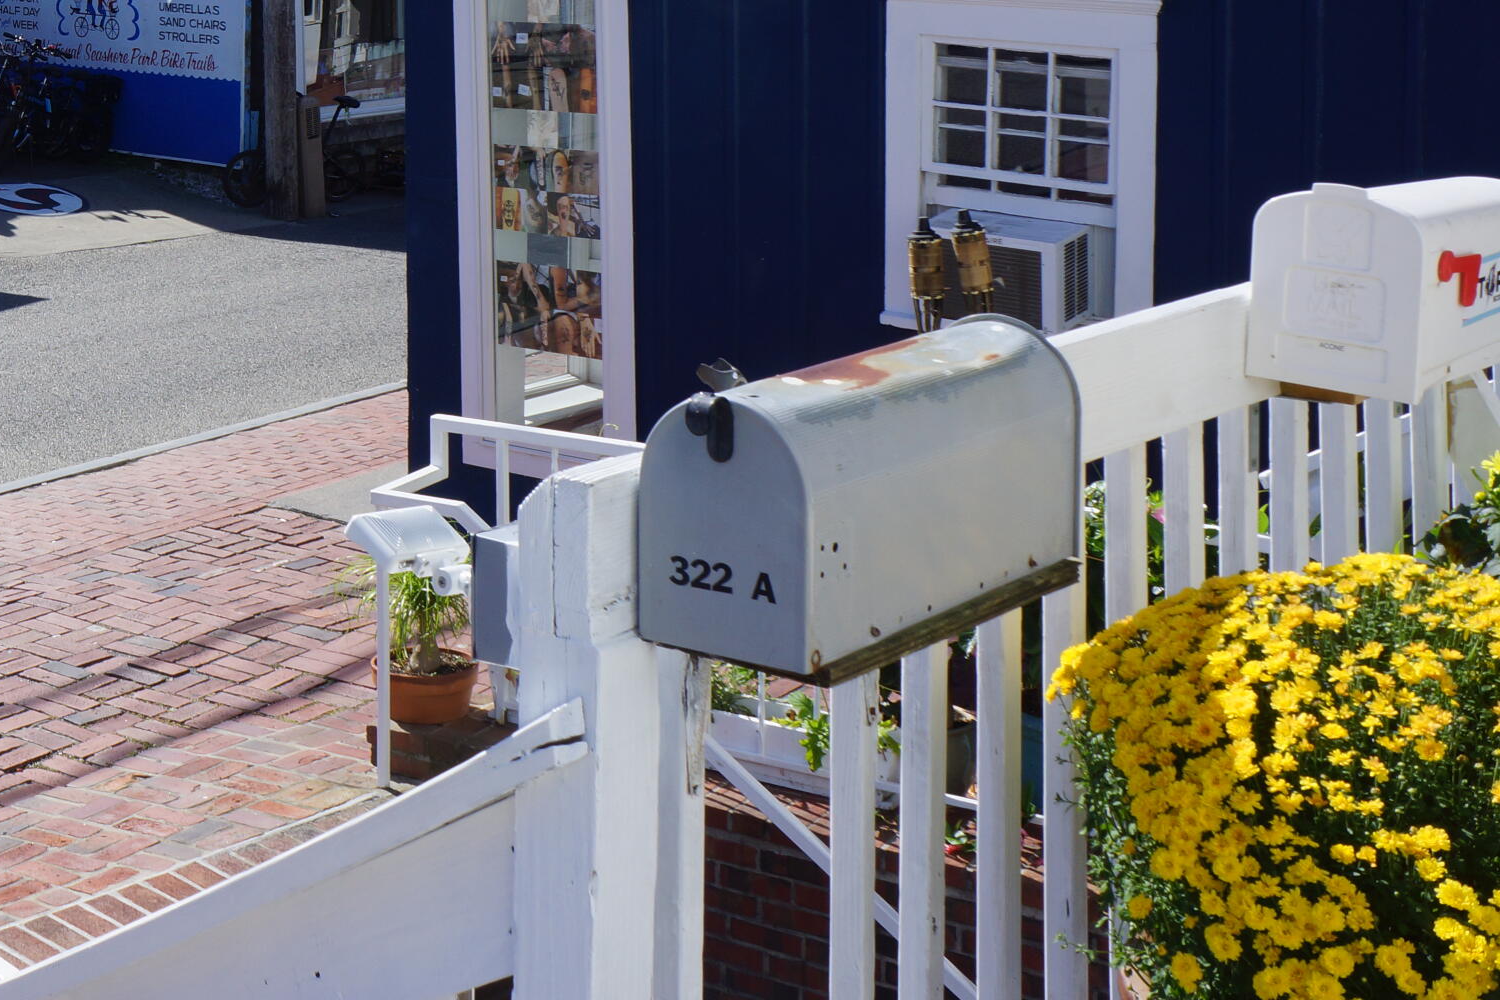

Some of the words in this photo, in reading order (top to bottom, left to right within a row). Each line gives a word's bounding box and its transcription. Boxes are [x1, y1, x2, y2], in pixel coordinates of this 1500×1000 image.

[22, 6, 41, 17] DAY
[158, 2, 220, 16] UMBRELLAS
[12, 20, 39, 30] WEEK
[158, 17, 186, 28] SAND
[189, 18, 226, 31] CHAIRS
[158, 31, 220, 45] STROLLERS
[85, 43, 129, 64] Seashore
[130, 48, 159, 67] Park
[161, 49, 185, 69] Bike
[185, 51, 218, 72] Trails
[668, 555, 733, 594] 322
[750, 572, 777, 605] A
